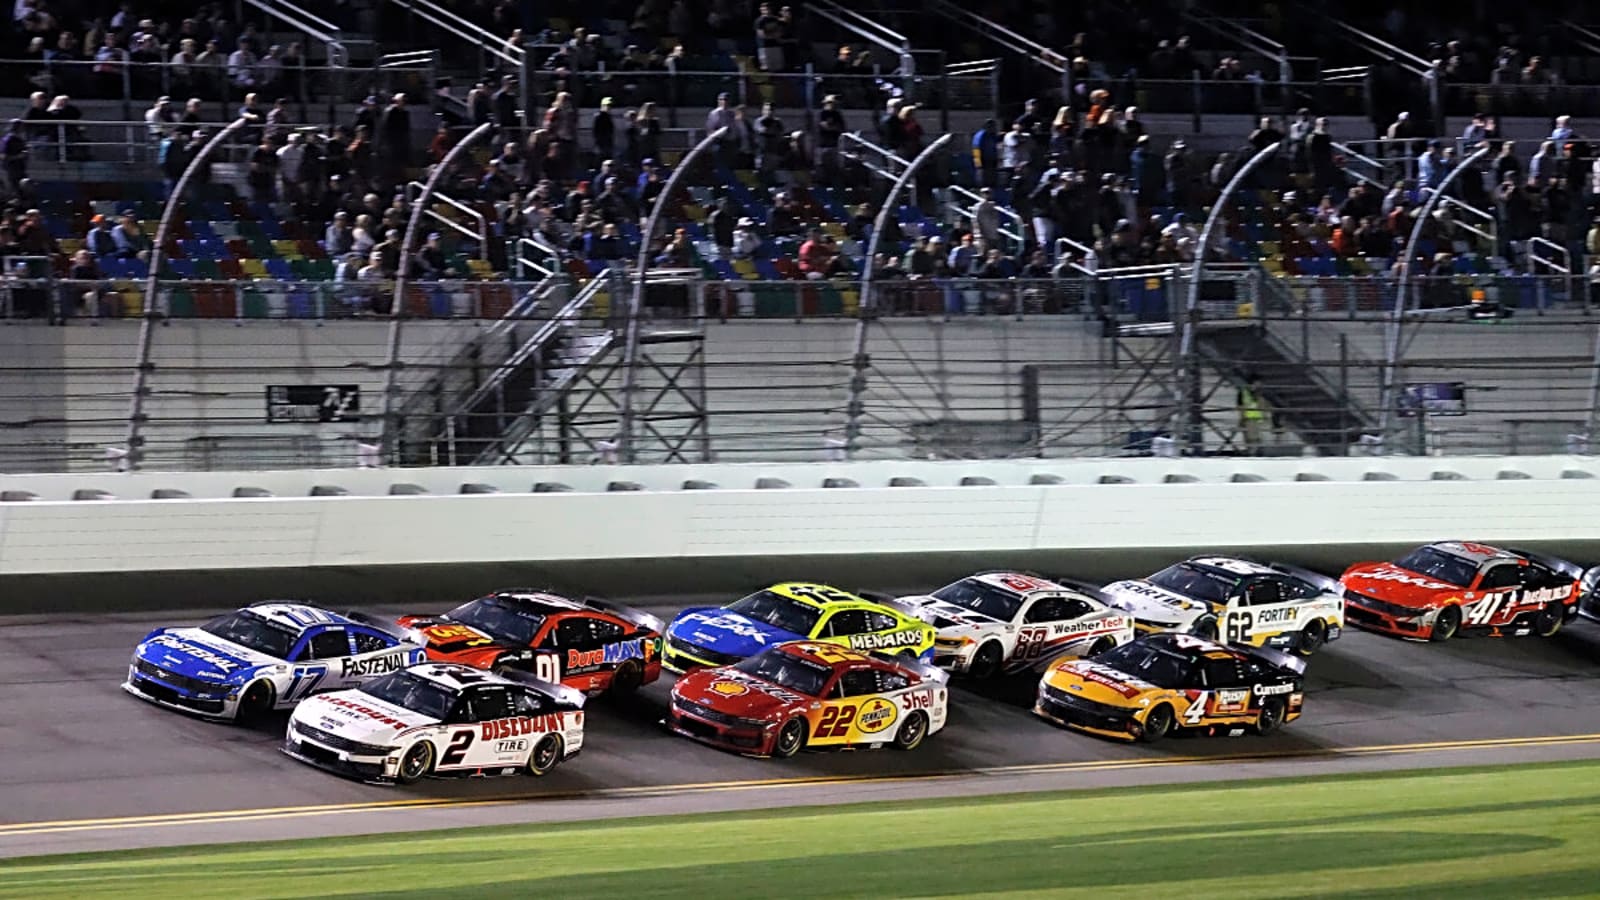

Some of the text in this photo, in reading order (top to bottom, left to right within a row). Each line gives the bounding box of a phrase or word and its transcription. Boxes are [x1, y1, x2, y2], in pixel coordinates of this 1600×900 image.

[1258, 606, 1300, 623] FORTIFY
[1469, 592, 1503, 624] 41
[849, 630, 923, 650] MENARDS
[1053, 616, 1124, 634] WeatherTech
[1227, 611, 1253, 642] 62
[339, 653, 406, 679] FASTENAL
[536, 654, 561, 685] 01
[282, 665, 328, 703] 17
[902, 689, 934, 710] Shell
[1253, 682, 1294, 696] Cummins
[813, 705, 856, 738] 22
[1184, 690, 1209, 724] 4
[480, 711, 566, 742] DISCOUNT
[438, 729, 475, 766] 2
[497, 740, 524, 752] TIRE
